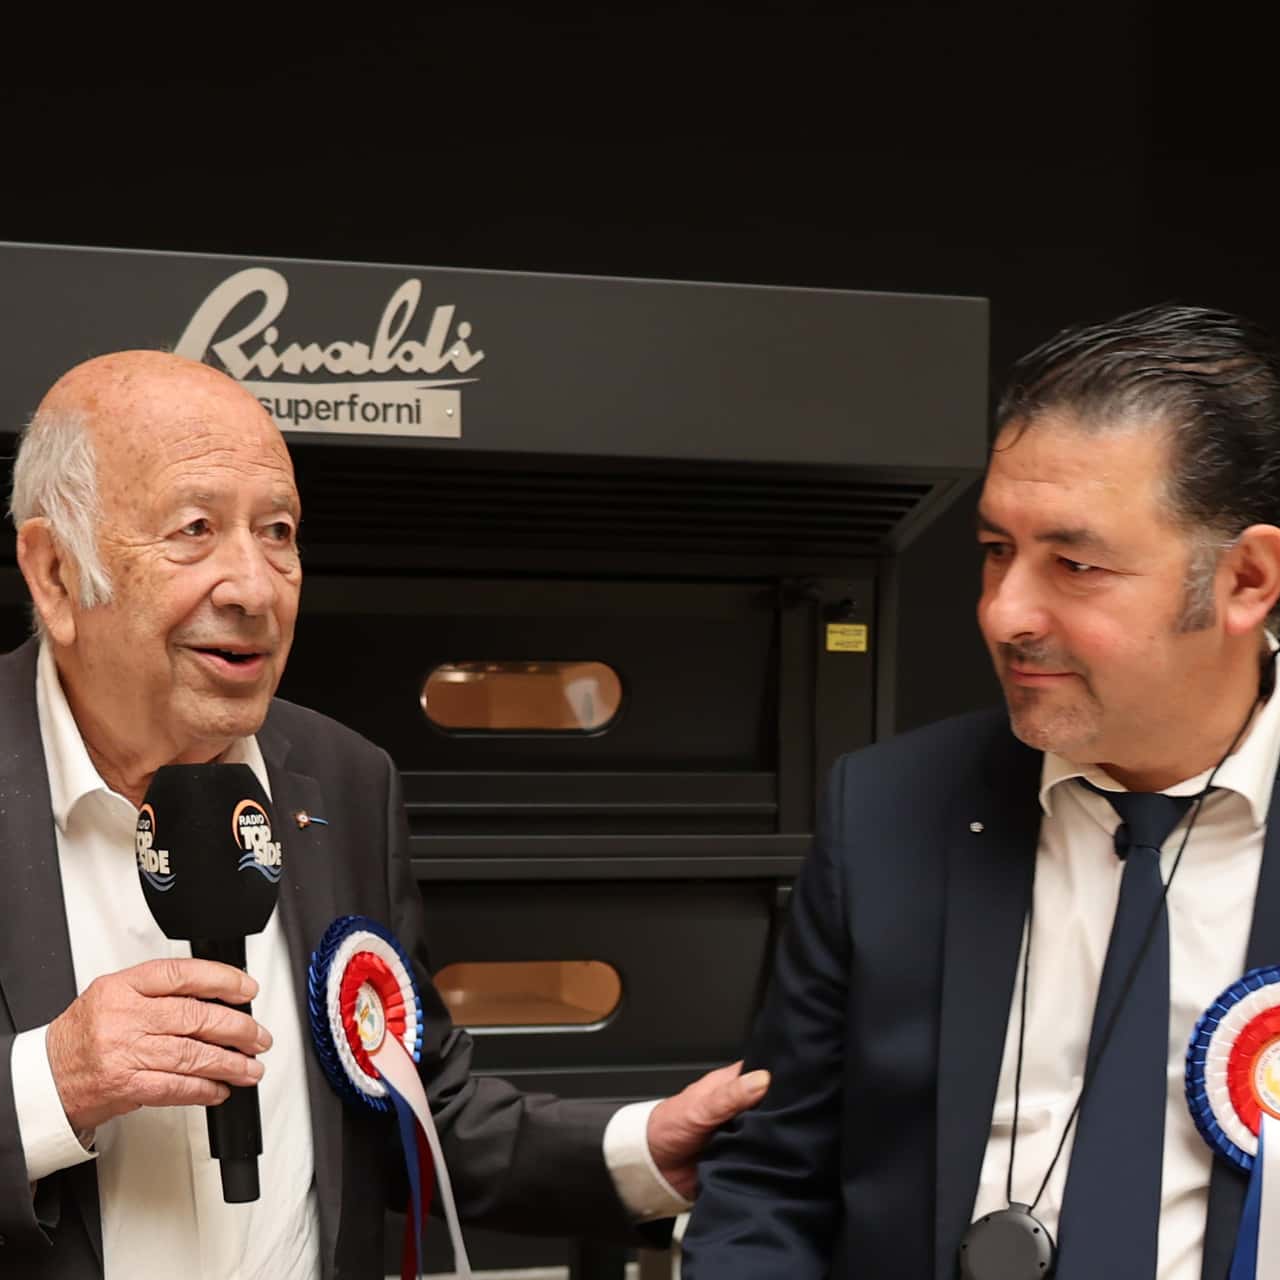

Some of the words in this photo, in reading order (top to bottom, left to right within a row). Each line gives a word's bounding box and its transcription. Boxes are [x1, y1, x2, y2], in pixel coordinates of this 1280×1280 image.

[172, 267, 485, 381] Rinaldi
[257, 391, 421, 426] superforni
[239, 814, 265, 827] RADIO
[136, 831, 154, 850] OP
[239, 825, 271, 850] TOP
